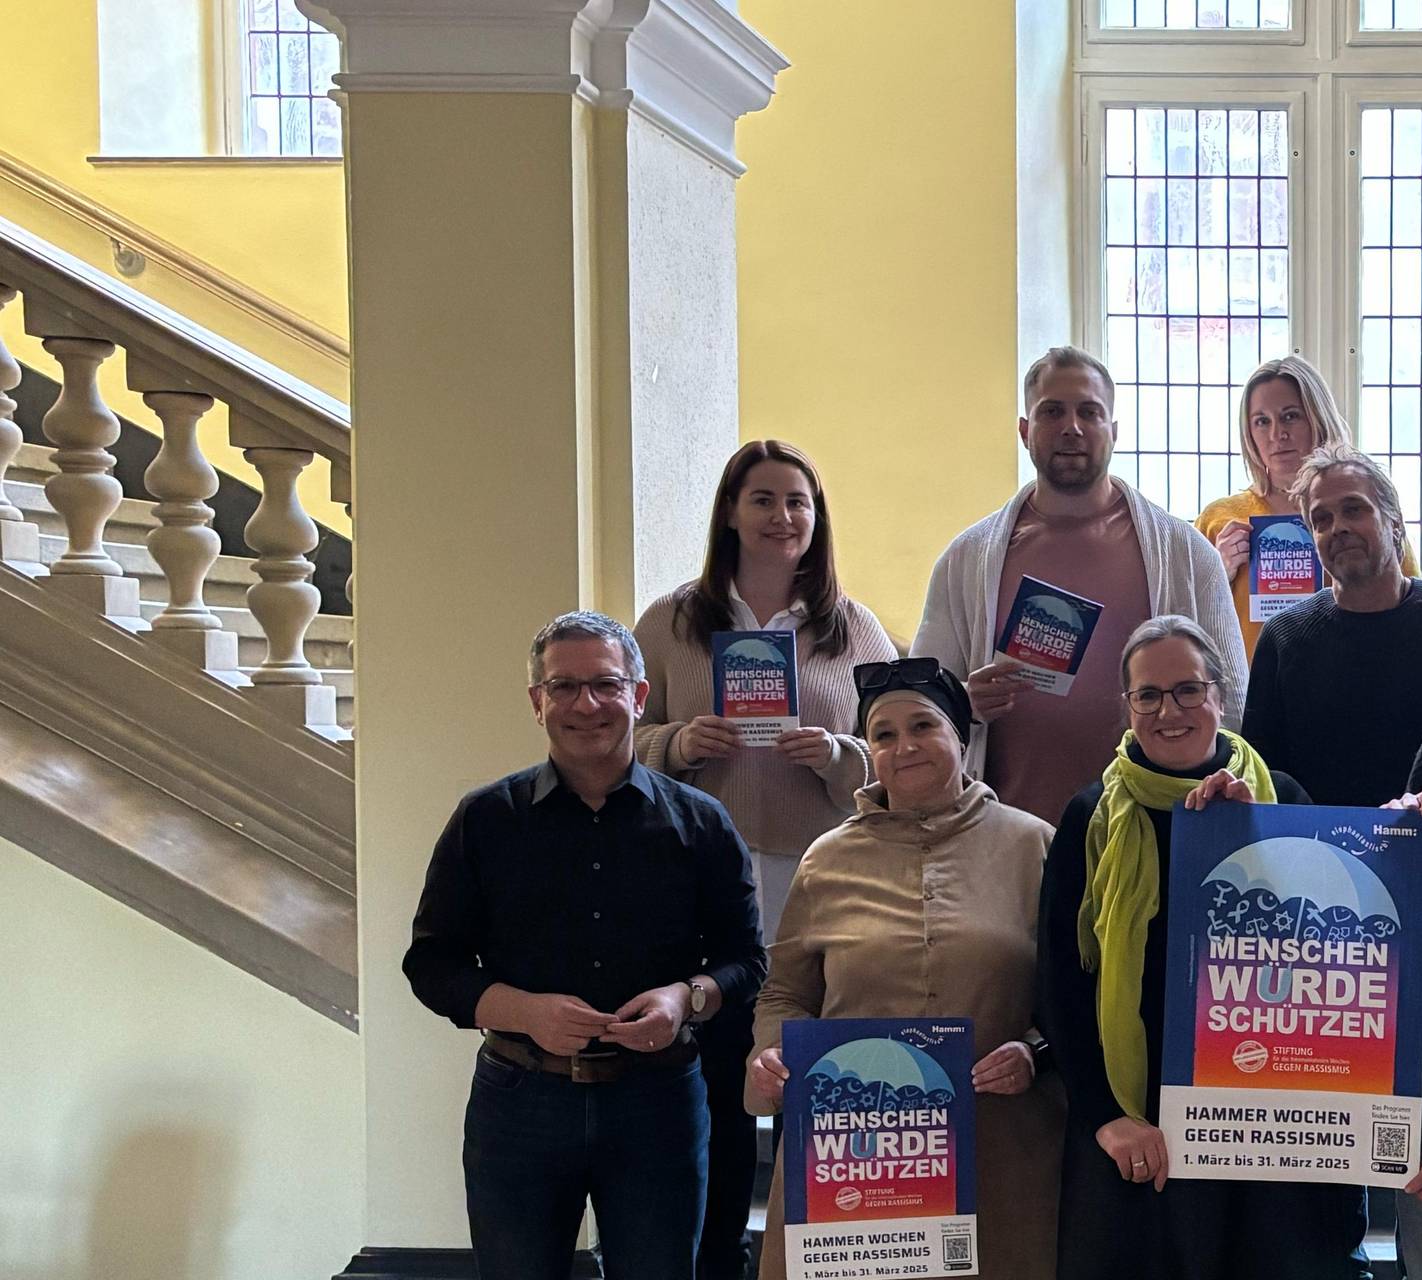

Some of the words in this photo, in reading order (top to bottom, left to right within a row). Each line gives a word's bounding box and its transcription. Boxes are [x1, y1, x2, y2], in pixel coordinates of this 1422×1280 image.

[1373, 824, 1418, 836] Hamm:
[1210, 936, 1388, 966] MENSCHEN
[1208, 962, 1388, 1008] WÜRDE
[1208, 1004, 1384, 1039] SCHÜTZEN
[1272, 1046, 1314, 1056] STIFTUNG
[1272, 1063, 1302, 1072] GEGEN
[1303, 1064, 1350, 1074] RASSISMUS
[814, 1108, 948, 1130] MENSCHEN
[1186, 1106, 1267, 1122] HAMMER
[1273, 1109, 1350, 1126] WOCHEN
[813, 1128, 948, 1160] WÜRDE
[1185, 1128, 1244, 1144] GEGEN
[1250, 1130, 1356, 1148] RASSISMUS
[815, 1158, 948, 1184] SCHÜTZEN
[1184, 1154, 1194, 1164] 1.
[1198, 1154, 1230, 1166] März
[1234, 1155, 1253, 1166] bis
[1257, 1156, 1274, 1167] 31.
[1279, 1156, 1312, 1168] März
[1316, 1158, 1350, 1170] 2025
[803, 1234, 864, 1248] HAMMER
[868, 1231, 926, 1245] WOCHEN
[804, 1251, 848, 1264] GEGEN
[853, 1246, 931, 1261] RASSISMUS
[804, 1271, 812, 1279] 1.
[815, 1270, 840, 1278] März
[842, 1268, 857, 1277] bis
[859, 1268, 872, 1276] 31.
[876, 1266, 900, 1276] März
[902, 1264, 928, 1274] 2025
